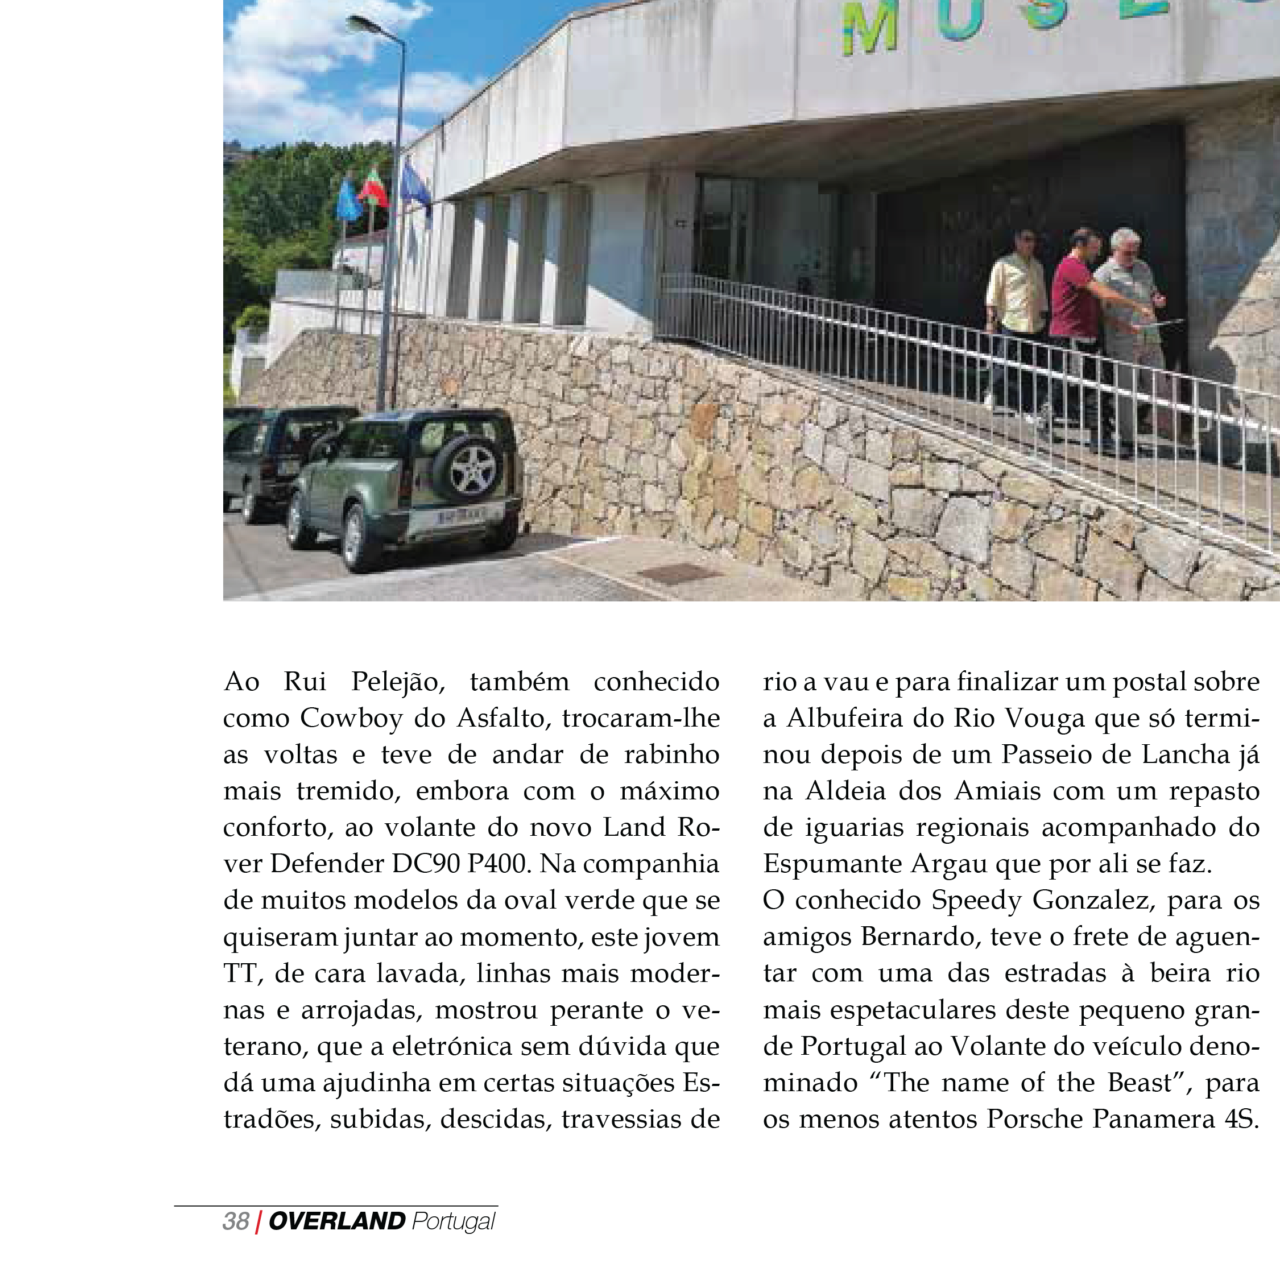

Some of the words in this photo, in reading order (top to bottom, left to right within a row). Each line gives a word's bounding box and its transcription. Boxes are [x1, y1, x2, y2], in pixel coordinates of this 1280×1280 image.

[224, 671, 259, 691] Ao
[285, 671, 326, 691] Rui
[352, 670, 444, 698] Pelejão,
[471, 670, 569, 691] também
[595, 670, 719, 691] conhecido
[764, 672, 796, 691] rio
[804, 677, 817, 691] a
[824, 677, 868, 691] vau
[876, 677, 888, 691] e
[896, 677, 950, 698] para
[958, 670, 1058, 691] finalizar
[1066, 677, 1105, 691] um
[1113, 670, 1186, 698] postal
[1194, 670, 1260, 691] sobre
[224, 713, 289, 727] como
[301, 707, 403, 735] Cowboy
[415, 707, 445, 727] do
[457, 707, 551, 730] Asfalto,
[562, 707, 720, 727] trocaram-lhe
[764, 713, 776, 727] a
[786, 707, 903, 727] Albufeira
[914, 707, 944, 727] do
[955, 708, 994, 727] Rio
[1005, 708, 1085, 735] Vouga
[1095, 713, 1139, 734] que
[1150, 708, 1175, 727] só
[1185, 708, 1259, 727] termi-
[224, 781, 281, 800] mais
[297, 780, 400, 803] tremido,
[417, 780, 509, 800] embora
[524, 786, 575, 800] com
[591, 786, 604, 800] o
[620, 781, 719, 800] máximo
[764, 786, 793, 800] na
[806, 780, 886, 800] Aldeia
[899, 780, 941, 800] dos
[955, 780, 1041, 800] Amiais
[1054, 786, 1104, 800] com
[1117, 786, 1157, 800] um
[1170, 782, 1259, 807] repasto
[224, 816, 333, 840] conforto,
[346, 823, 373, 836] ao
[385, 816, 475, 836] volante
[488, 816, 518, 836] do
[530, 823, 591, 836] novo
[604, 816, 666, 836] Land
[678, 817, 720, 836] Ro-
[764, 816, 793, 836] de
[806, 817, 904, 844] iguarias
[917, 817, 1029, 844] regionais
[1042, 816, 1216, 843] acompanhado
[1229, 816, 1259, 836] do
[224, 859, 263, 873] ver
[271, 852, 384, 873] Defender
[392, 853, 460, 873] DC90
[468, 853, 531, 873] P400.
[540, 853, 576, 873] Na
[584, 852, 719, 880] companhia
[763, 889, 784, 909] O
[796, 889, 920, 909] conhecido
[933, 889, 1022, 917] Speedy
[1033, 889, 1155, 912] Gonzalez,
[1168, 895, 1222, 916] para
[1234, 895, 1260, 909] os
[224, 927, 338, 953] quiseram
[343, 927, 418, 954] juntar
[425, 932, 452, 946] ao
[461, 929, 583, 949] momento,
[592, 929, 638, 946] este
[644, 927, 720, 954] jovem
[764, 927, 851, 953] amigos
[861, 925, 981, 949] Bernardo,
[991, 928, 1041, 946] teve
[1050, 932, 1064, 946] o
[1074, 925, 1128, 946] frete
[1138, 925, 1166, 946] de
[1176, 932, 1259, 953] aguen-
[224, 1005, 264, 1019] nas
[277, 1005, 289, 1019] e
[302, 998, 422, 1026] arrojadas,
[436, 1001, 536, 1019] mostrou
[550, 1001, 643, 1026] perante
[656, 1005, 670, 1019] o
[682, 1005, 720, 1019] ve-
[764, 1000, 820, 1019] mais
[831, 999, 996, 1026] espetaculares
[1006, 998, 1069, 1019] deste
[1079, 1005, 1184, 1026] pequeno
[1195, 1005, 1260, 1026] gran-
[224, 1071, 253, 1092] dá
[261, 1078, 315, 1092] uma
[323, 1071, 431, 1099] ajudinha
[439, 1078, 476, 1092] em
[484, 1074, 554, 1092] certas
[563, 1073, 674, 1097] situações
[683, 1072, 720, 1092] Es-
[764, 1071, 857, 1092] minado
[870, 1071, 929, 1092] “The
[942, 1078, 1009, 1092] name
[1021, 1071, 1045, 1092] of
[1058, 1071, 1095, 1092] the
[1108, 1071, 1192, 1095] Beast”,
[1206, 1078, 1260, 1099] para
[224, 1108, 320, 1131] tradões,
[331, 1108, 431, 1131] subidas,
[441, 1108, 551, 1131] descidas,
[562, 1109, 681, 1128] travessias
[691, 1108, 720, 1128] de
[764, 1114, 789, 1128] os
[800, 1114, 879, 1128] menos
[889, 1111, 977, 1128] atentos
[987, 1108, 1083, 1128] Porsche
[1093, 1109, 1215, 1128] Panamera
[1225, 1108, 1258, 1128] 4S.
[223, 1212, 249, 1230] 38
[269, 1211, 406, 1230] OVERLAND
[412, 1212, 496, 1234] Portugal
